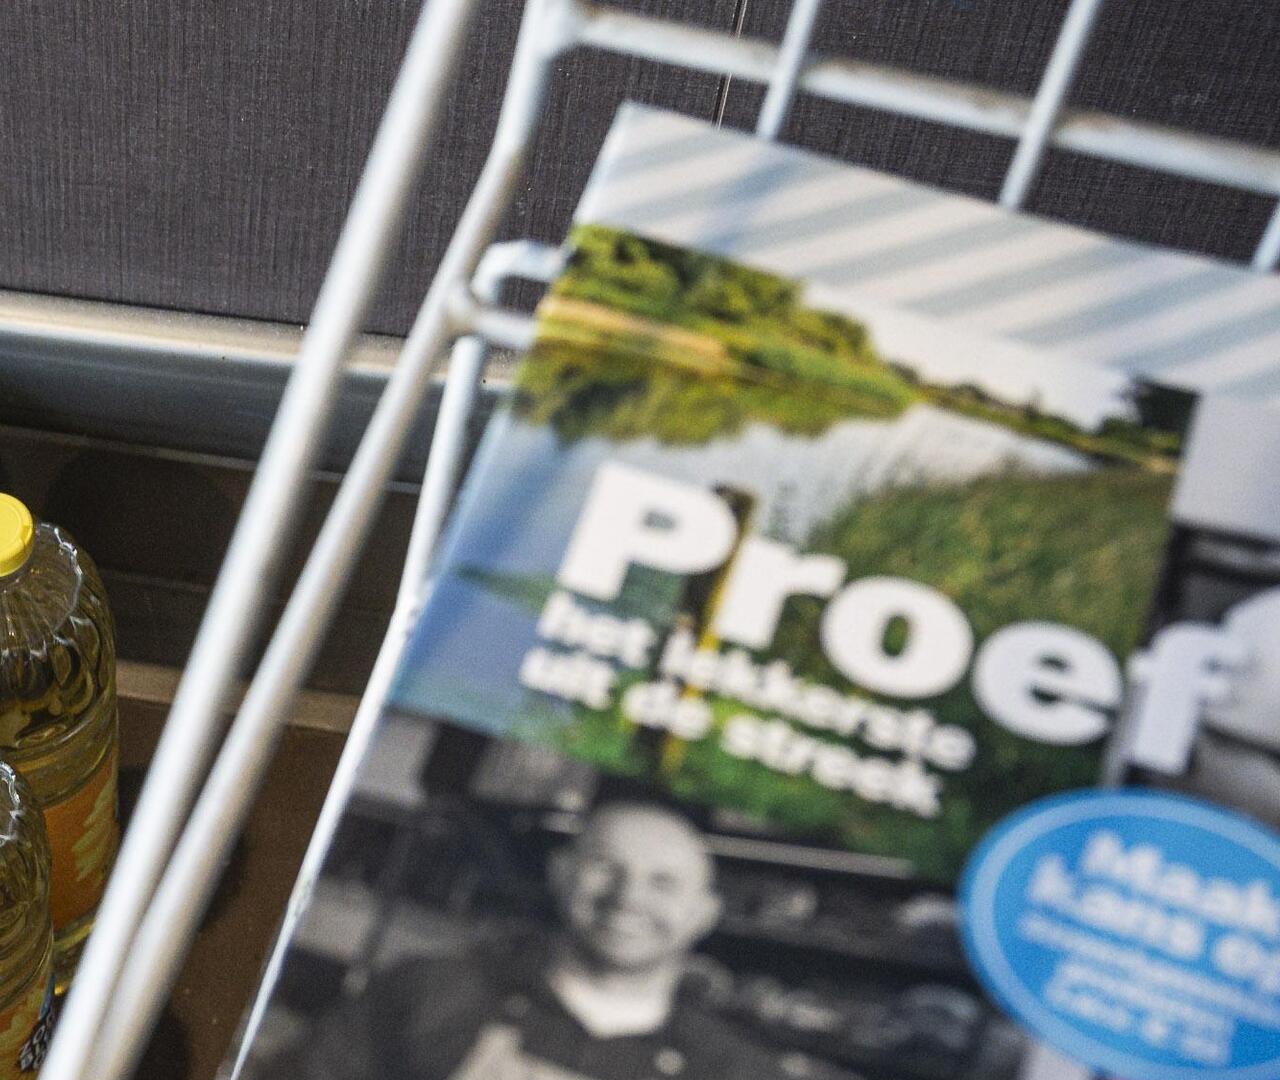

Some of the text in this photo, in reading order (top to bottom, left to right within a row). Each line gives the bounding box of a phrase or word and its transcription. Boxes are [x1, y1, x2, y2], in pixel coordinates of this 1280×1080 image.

[537, 588, 977, 773] het lekkerste
[557, 461, 1235, 776] Proef
[520, 648, 945, 818] uit de streek
